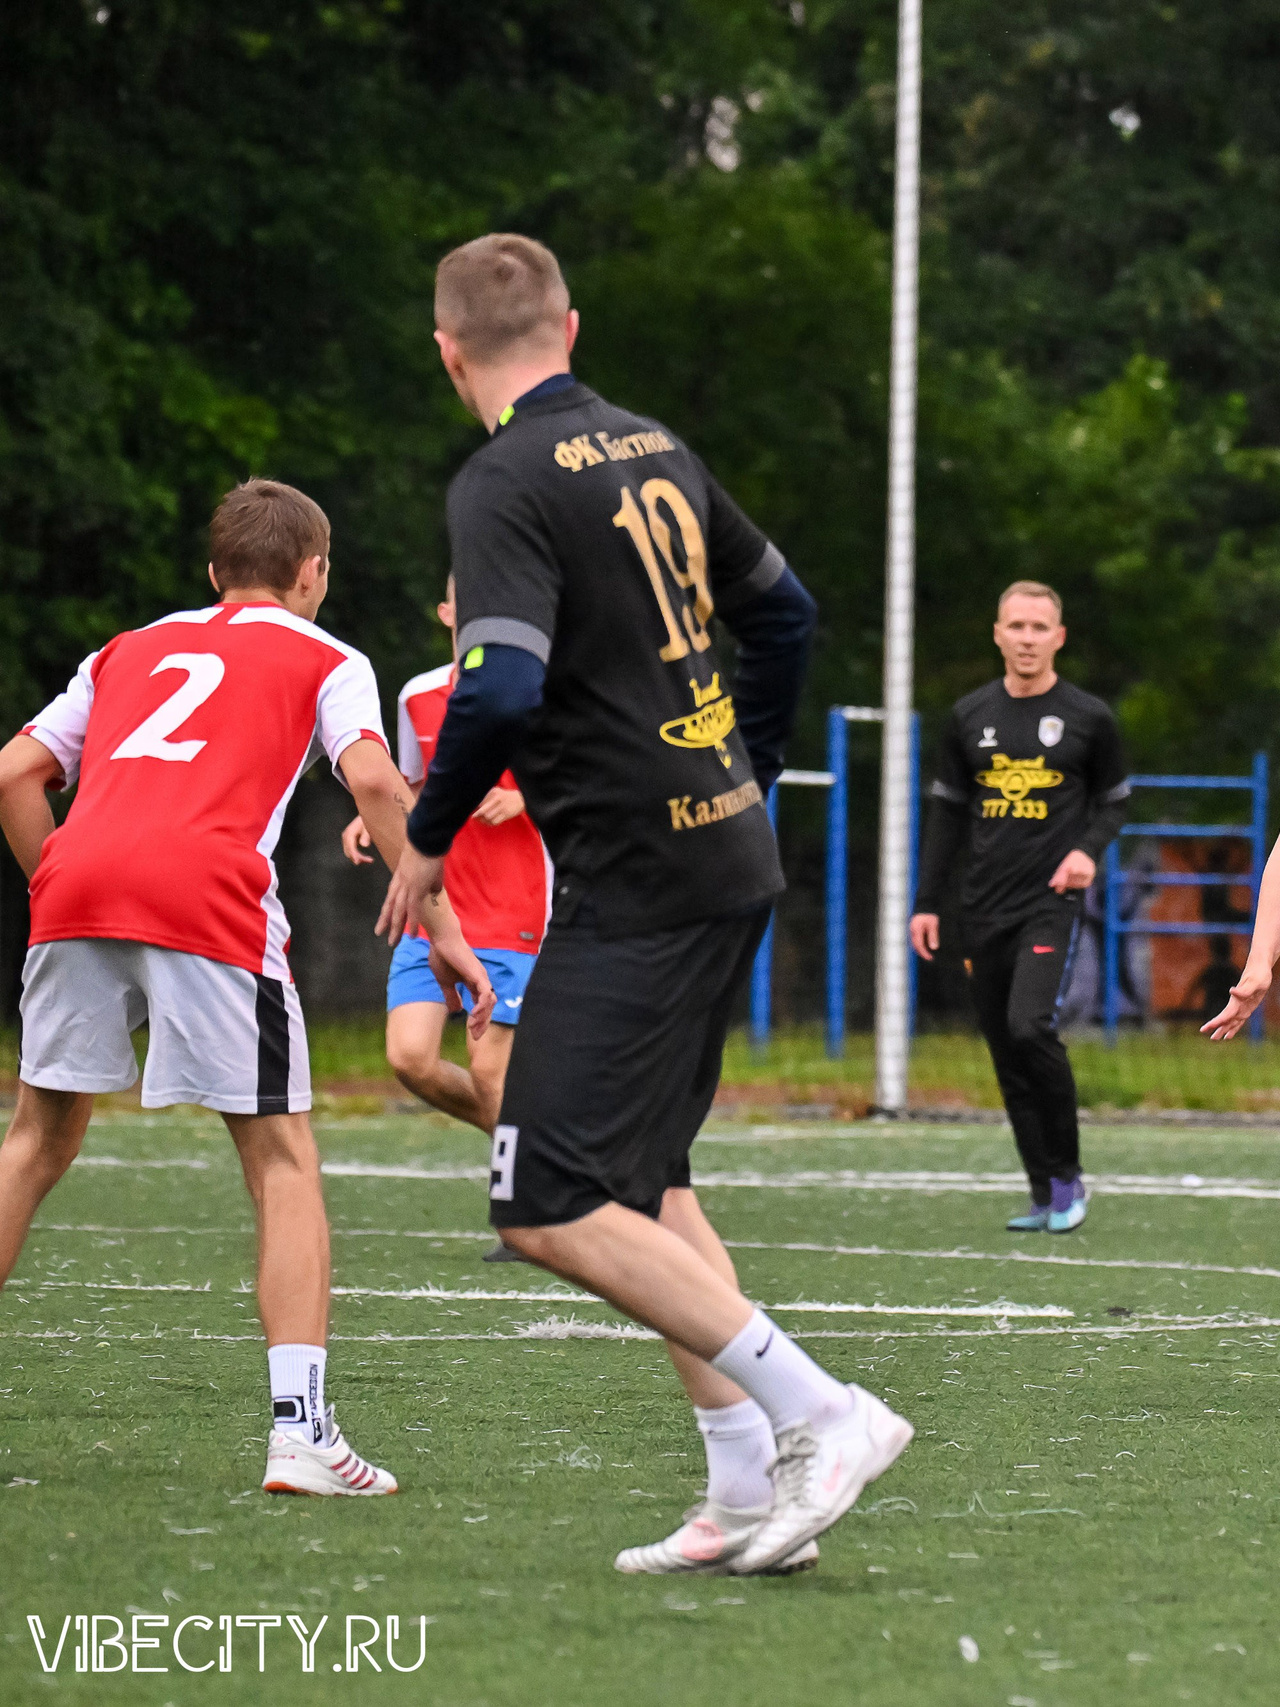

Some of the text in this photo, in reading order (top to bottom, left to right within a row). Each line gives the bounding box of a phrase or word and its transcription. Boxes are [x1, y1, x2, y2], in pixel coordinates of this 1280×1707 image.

[554, 433, 606, 472] ФК
[612, 477, 714, 662] 19
[109, 652, 225, 763] 2
[982, 799, 1048, 820] 777 333
